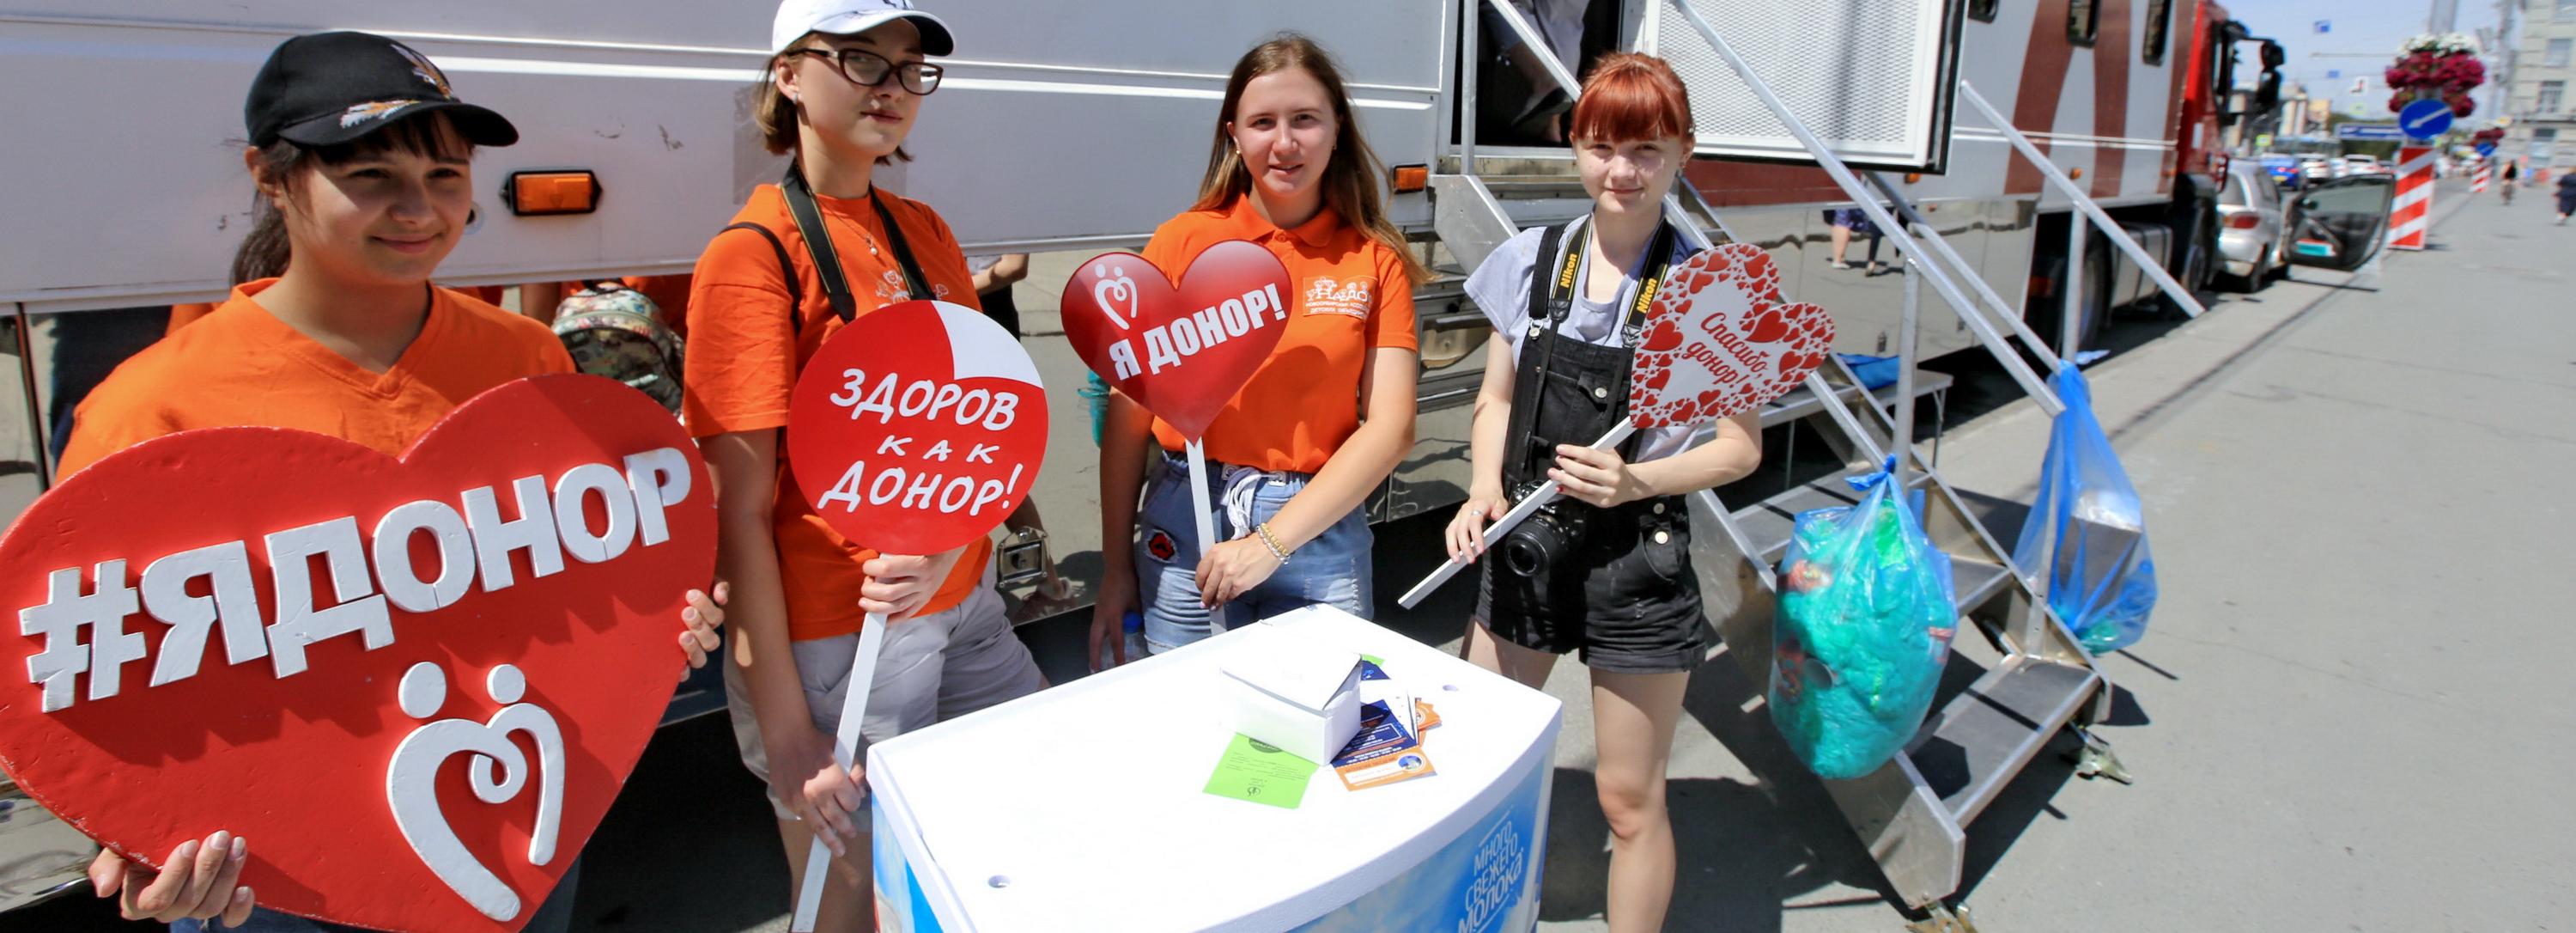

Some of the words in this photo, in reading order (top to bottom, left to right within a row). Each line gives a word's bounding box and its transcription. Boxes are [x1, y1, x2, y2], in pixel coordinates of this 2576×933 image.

[1560, 253, 1577, 288] Nikon
[1637, 277, 1657, 314] Nikon
[1109, 338, 1142, 381] Я
[1143, 283, 1286, 375] ДОНОР!
[1701, 312, 1770, 379] Спасибо,
[1682, 342, 1750, 388] донор!
[829, 368, 1019, 431] ЗДОРОВ
[877, 435, 1000, 464] КАК
[817, 460, 1024, 516] ДОНОР!
[18, 447, 691, 713] #ЯДОНОР
[1465, 832, 1518, 912] СВЕЖЕГО
[1473, 820, 1512, 877] МНОГО
